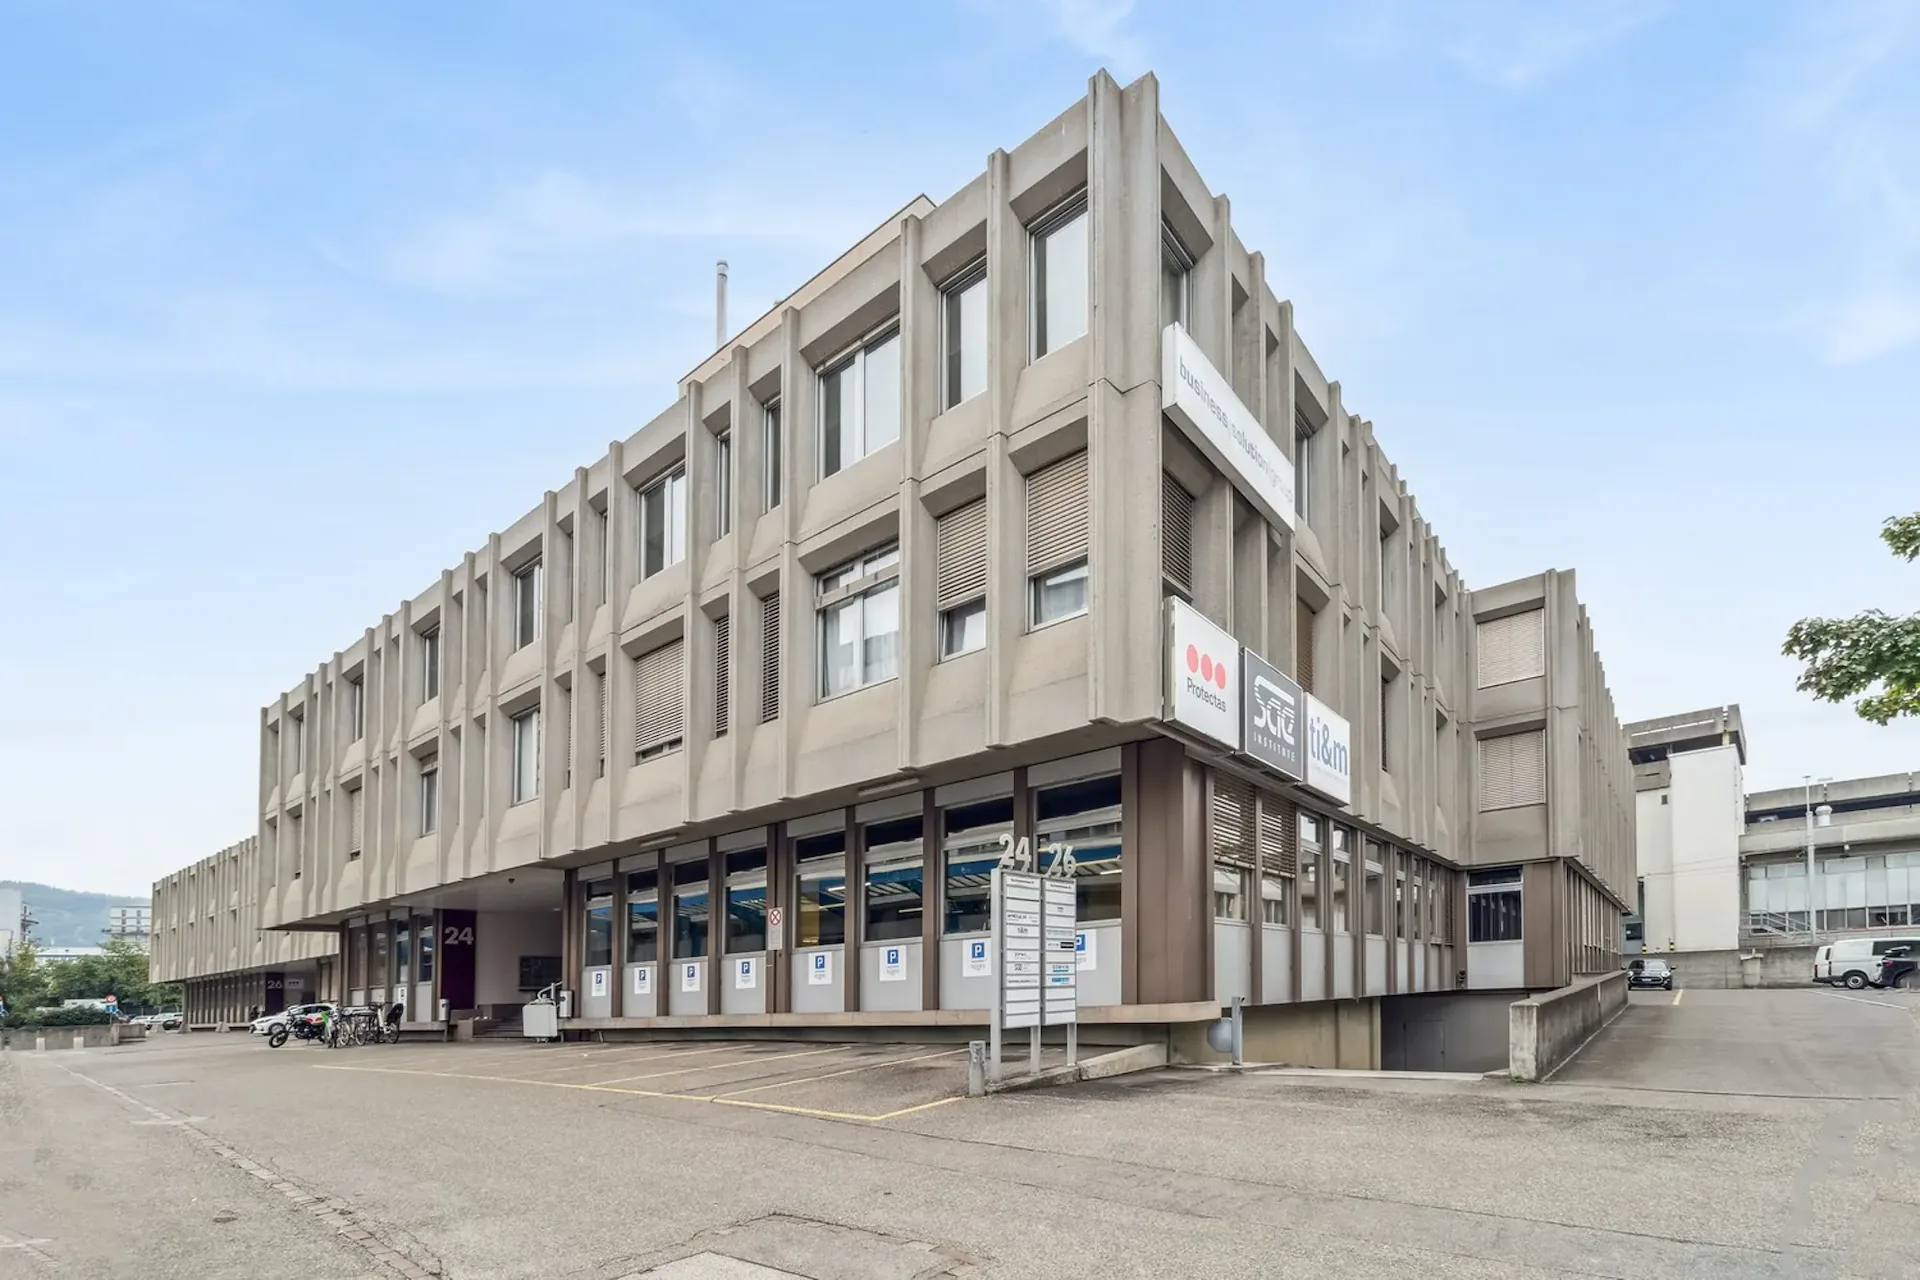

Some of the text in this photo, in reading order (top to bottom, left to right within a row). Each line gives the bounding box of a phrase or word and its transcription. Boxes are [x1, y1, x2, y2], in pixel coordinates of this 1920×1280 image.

[1180, 355, 1228, 429] business
[1186, 676, 1226, 712] Protectas
[1309, 716, 1347, 776] ti&m
[999, 833, 1032, 872] 24
[1048, 842, 1076, 878] 26
[445, 926, 474, 945] 24
[267, 980, 283, 989] 26
